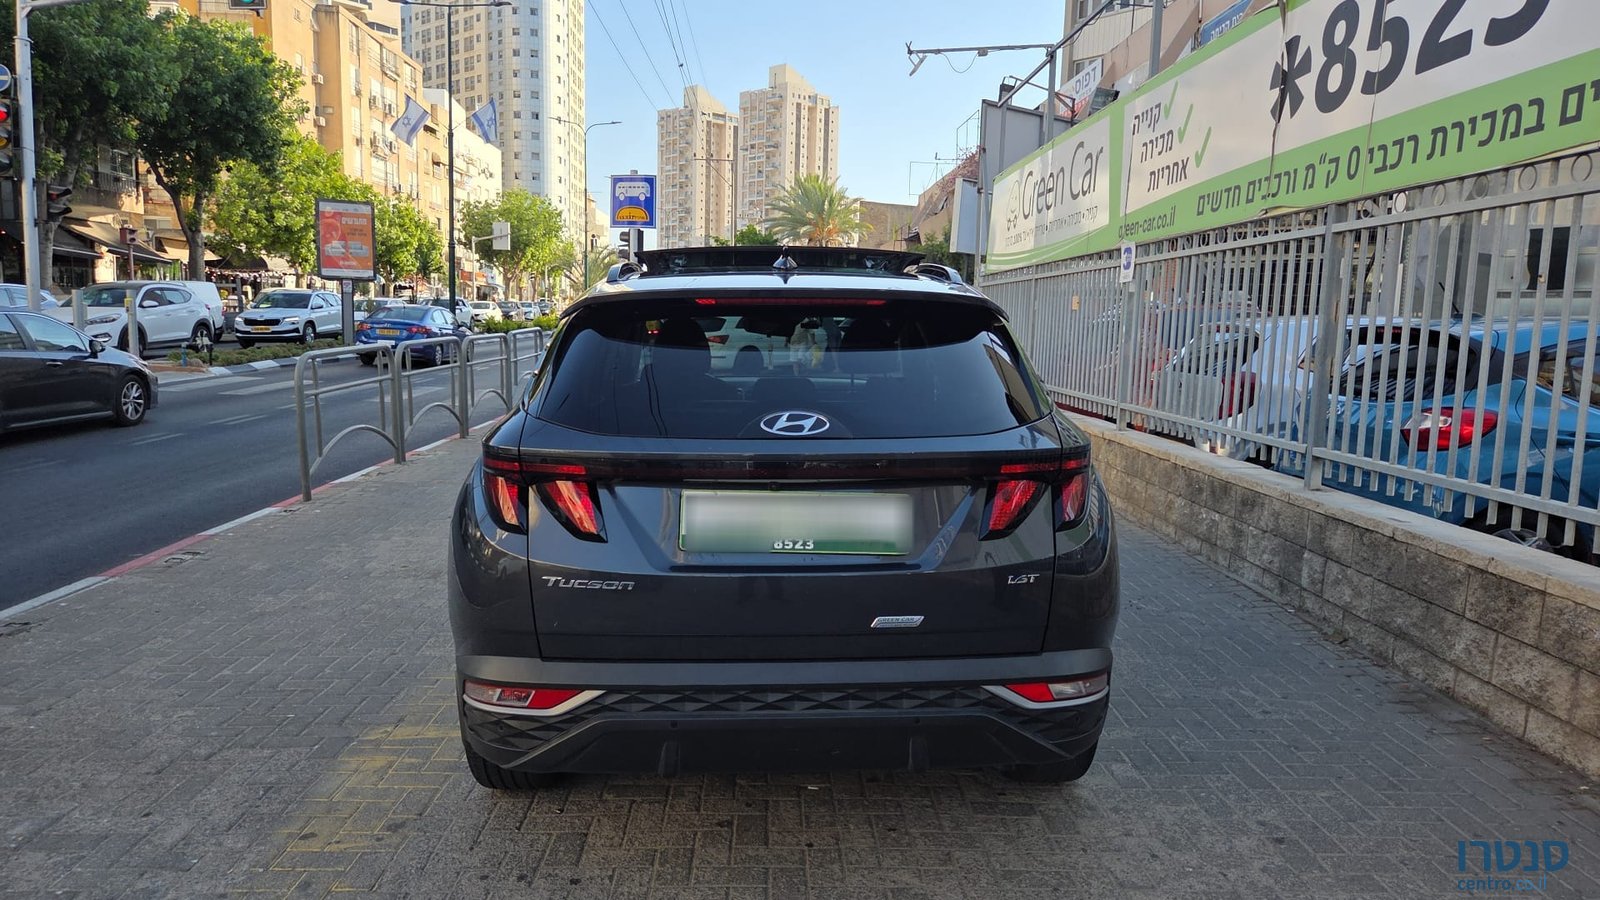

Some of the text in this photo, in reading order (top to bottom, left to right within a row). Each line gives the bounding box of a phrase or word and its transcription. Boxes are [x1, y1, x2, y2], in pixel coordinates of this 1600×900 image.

[1075, 66, 1097, 95] דפוס
[1132, 102, 1162, 136] קנייה
[1426, 97, 1545, 161] במכירת
[1140, 129, 1174, 163] מכירה
[1367, 134, 1420, 174] רכבי
[1022, 141, 1104, 220] Green Car
[1147, 157, 1190, 193] אחריות
[1245, 168, 1298, 204] ורכבים
[1196, 184, 1242, 217] חדשים
